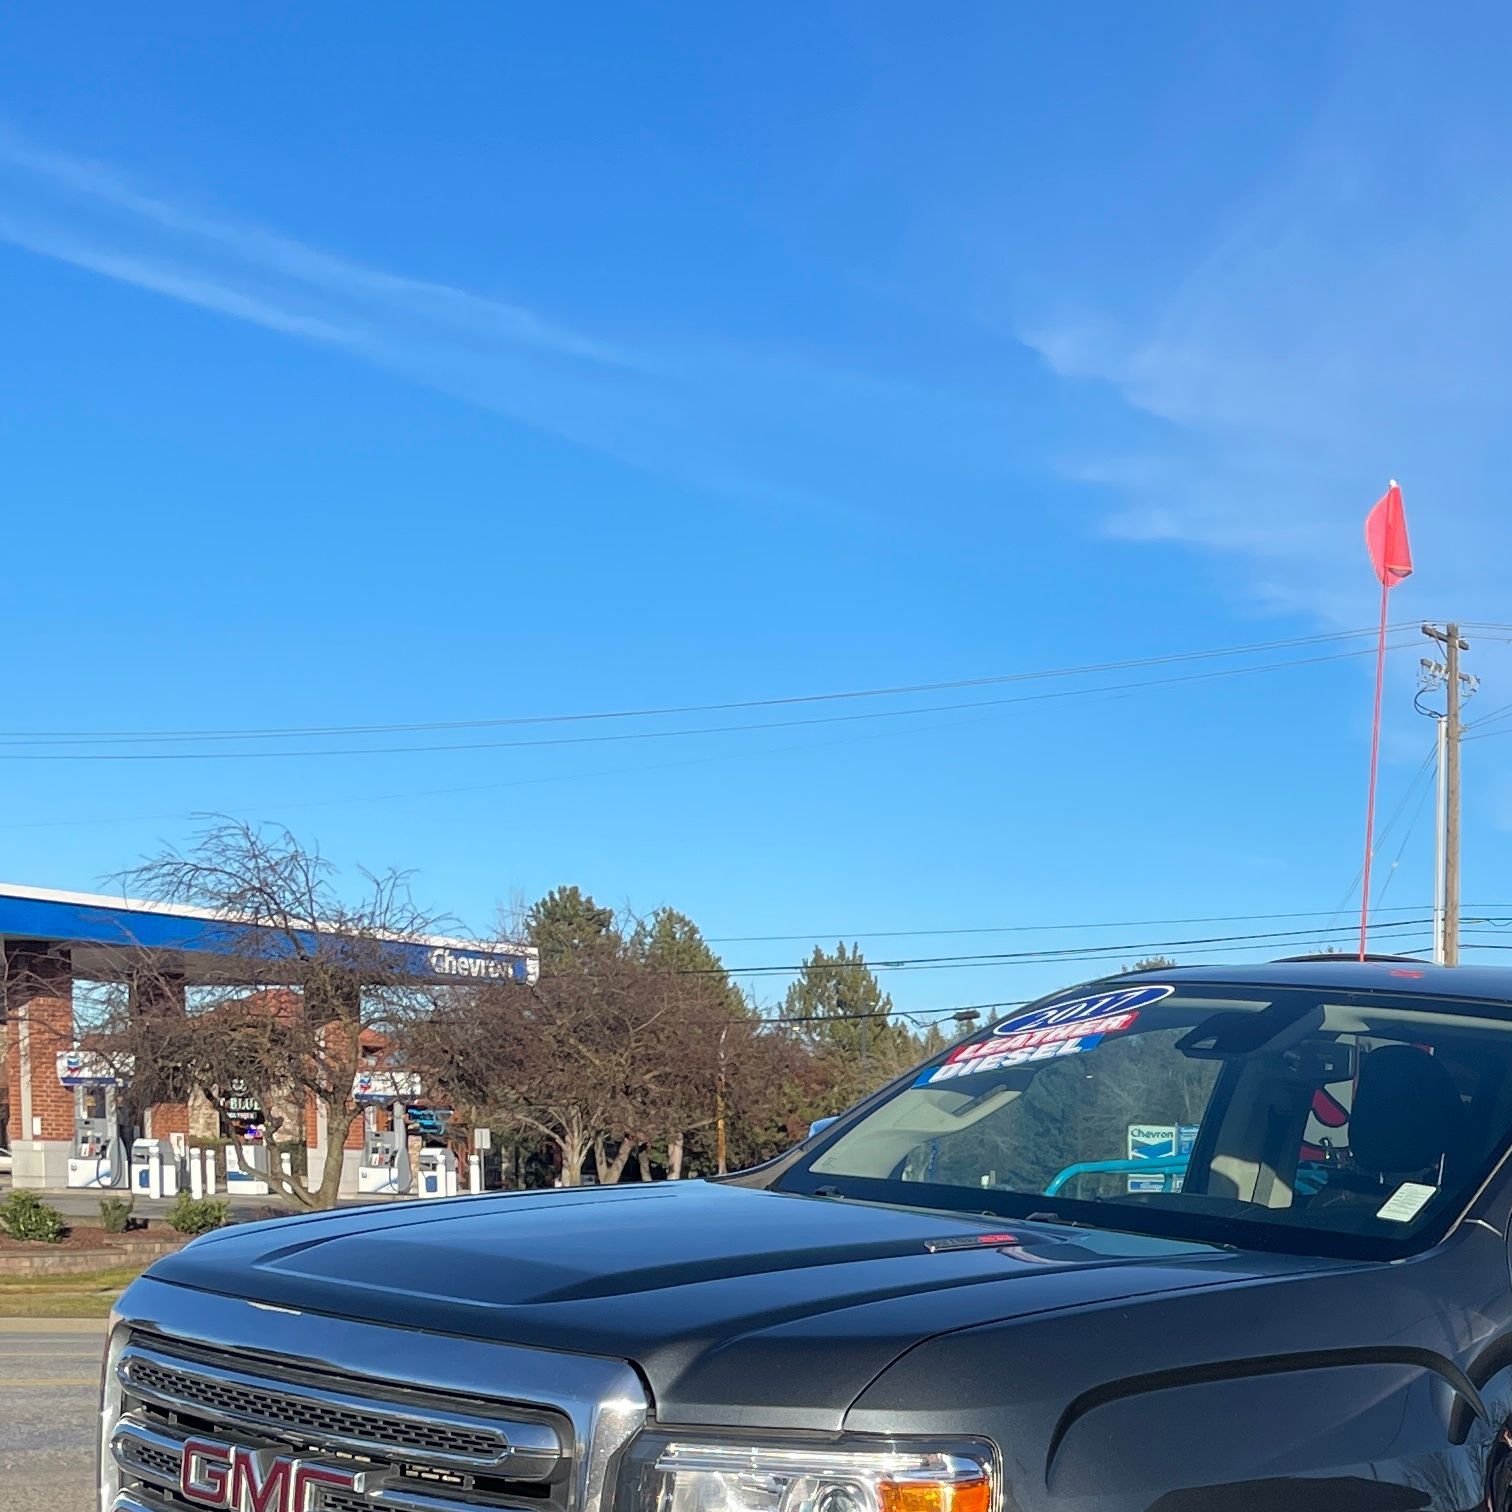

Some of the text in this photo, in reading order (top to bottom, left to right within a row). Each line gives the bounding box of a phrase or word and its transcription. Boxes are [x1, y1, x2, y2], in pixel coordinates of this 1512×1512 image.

[1014, 989, 1150, 1032] 2017
[927, 1037, 1083, 1084] DIESEL
[954, 1014, 1132, 1063] LEATHER
[1130, 1127, 1174, 1139] Chevron
